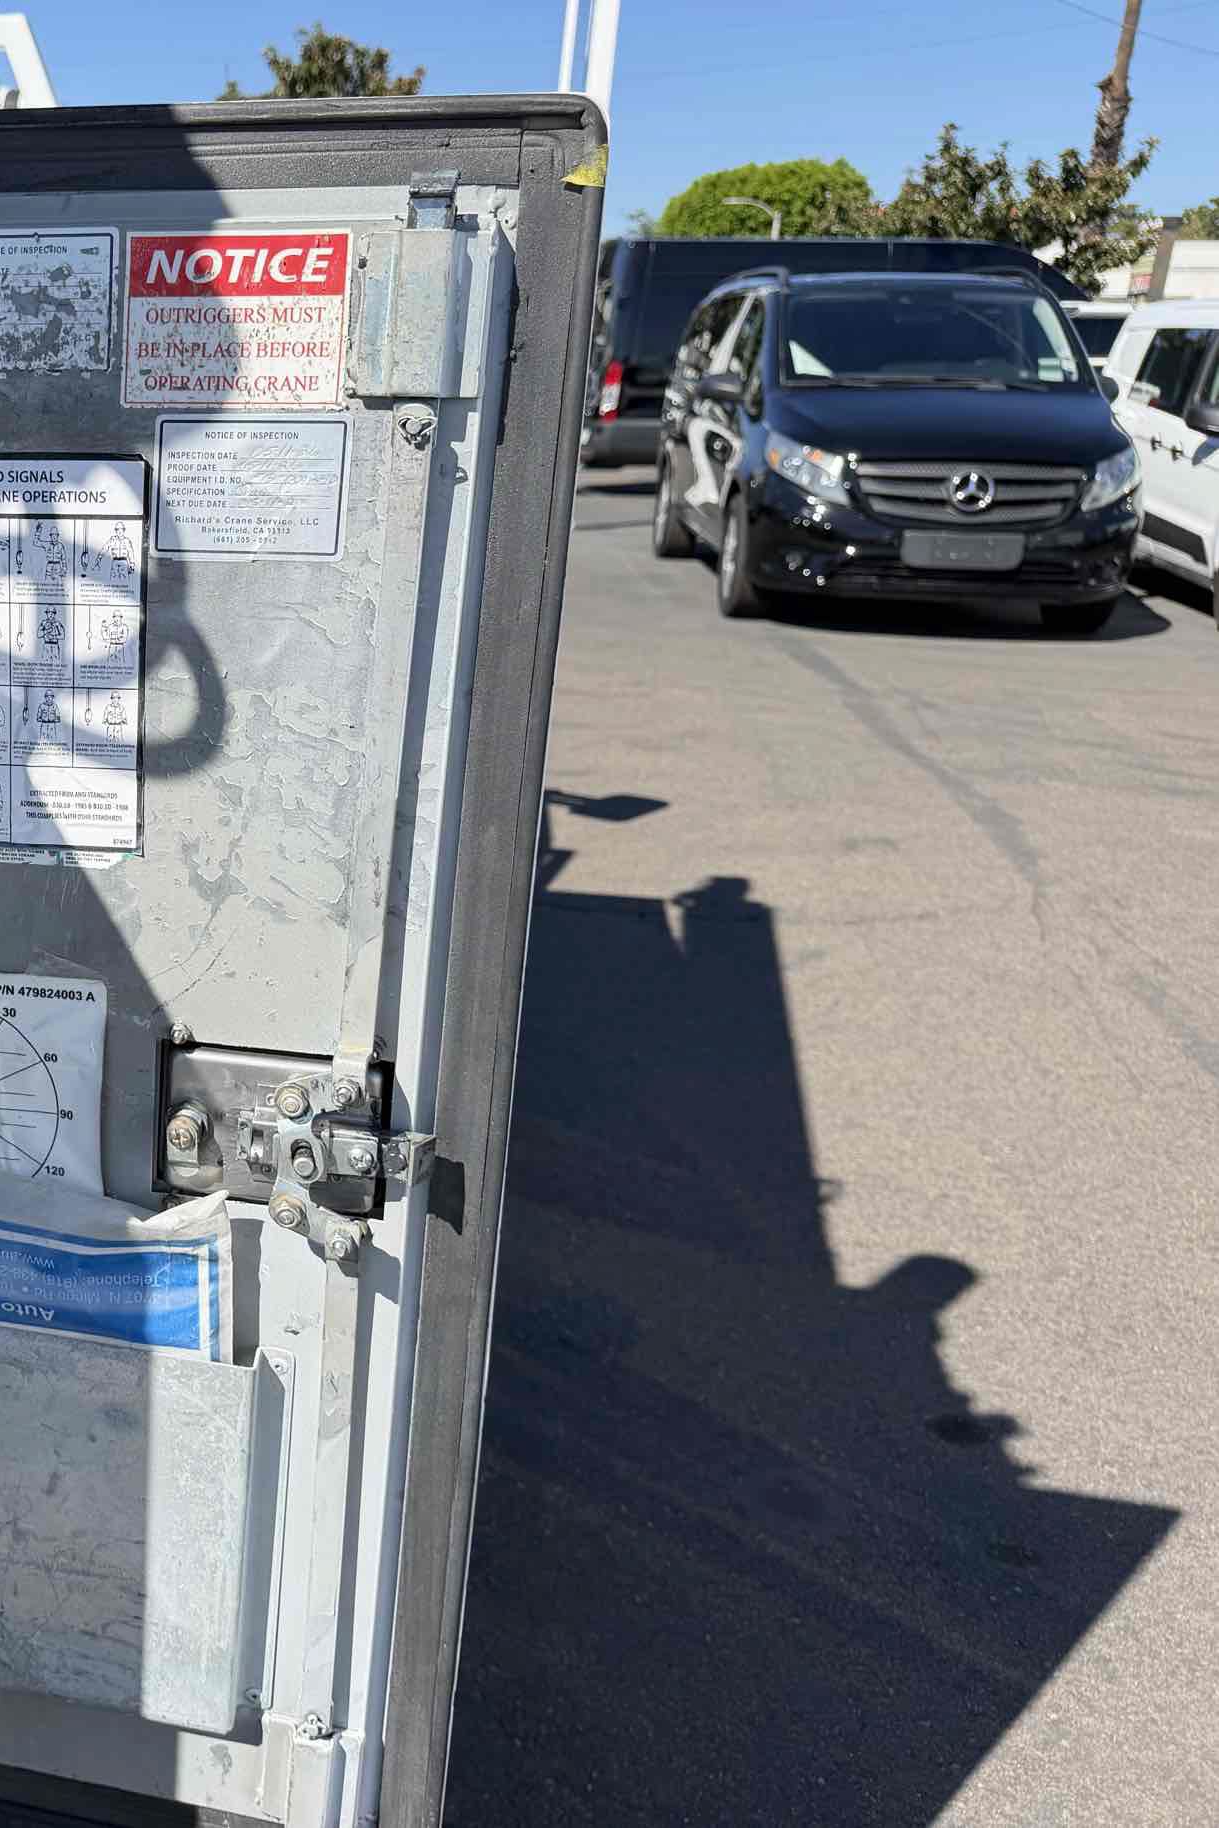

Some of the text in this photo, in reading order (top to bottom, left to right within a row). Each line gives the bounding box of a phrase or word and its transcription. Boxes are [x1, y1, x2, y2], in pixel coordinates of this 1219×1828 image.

[8, 247, 17, 255] OF
[20, 245, 67, 254] INSPECTION
[146, 247, 334, 284] NOTICE
[146, 307, 326, 324] OUTRIGGERS MUST
[137, 342, 161, 359] BE
[256, 342, 330, 358] BEFORE
[144, 376, 319, 392] OPERATING CRANE
[205, 432, 235, 440] NOTICE
[250, 432, 299, 440] INSPECTION
[168, 452, 238, 460] INSPECTION DATE
[7, 470, 64, 484] SIGNALS
[167, 476, 212, 484] EQUIPMENT
[22, 490, 107, 504] OPERATIONS
[166, 488, 225, 496] SPECIFICATION
[165, 499, 186, 507] NEXT
[188, 500, 205, 508] DUE
[175, 516, 221, 524] Richard's
[224, 517, 253, 525] Crane
[300, 518, 319, 526] LLC
[18, 985, 82, 1001] 479824003
[85, 991, 95, 1002] A
[2, 1007, 16, 1018] 30
[43, 1053, 58, 1063] 60
[60, 1110, 73, 1120] 90
[46, 1166, 65, 1177] 120
[1, 1301, 55, 1321] Auto
